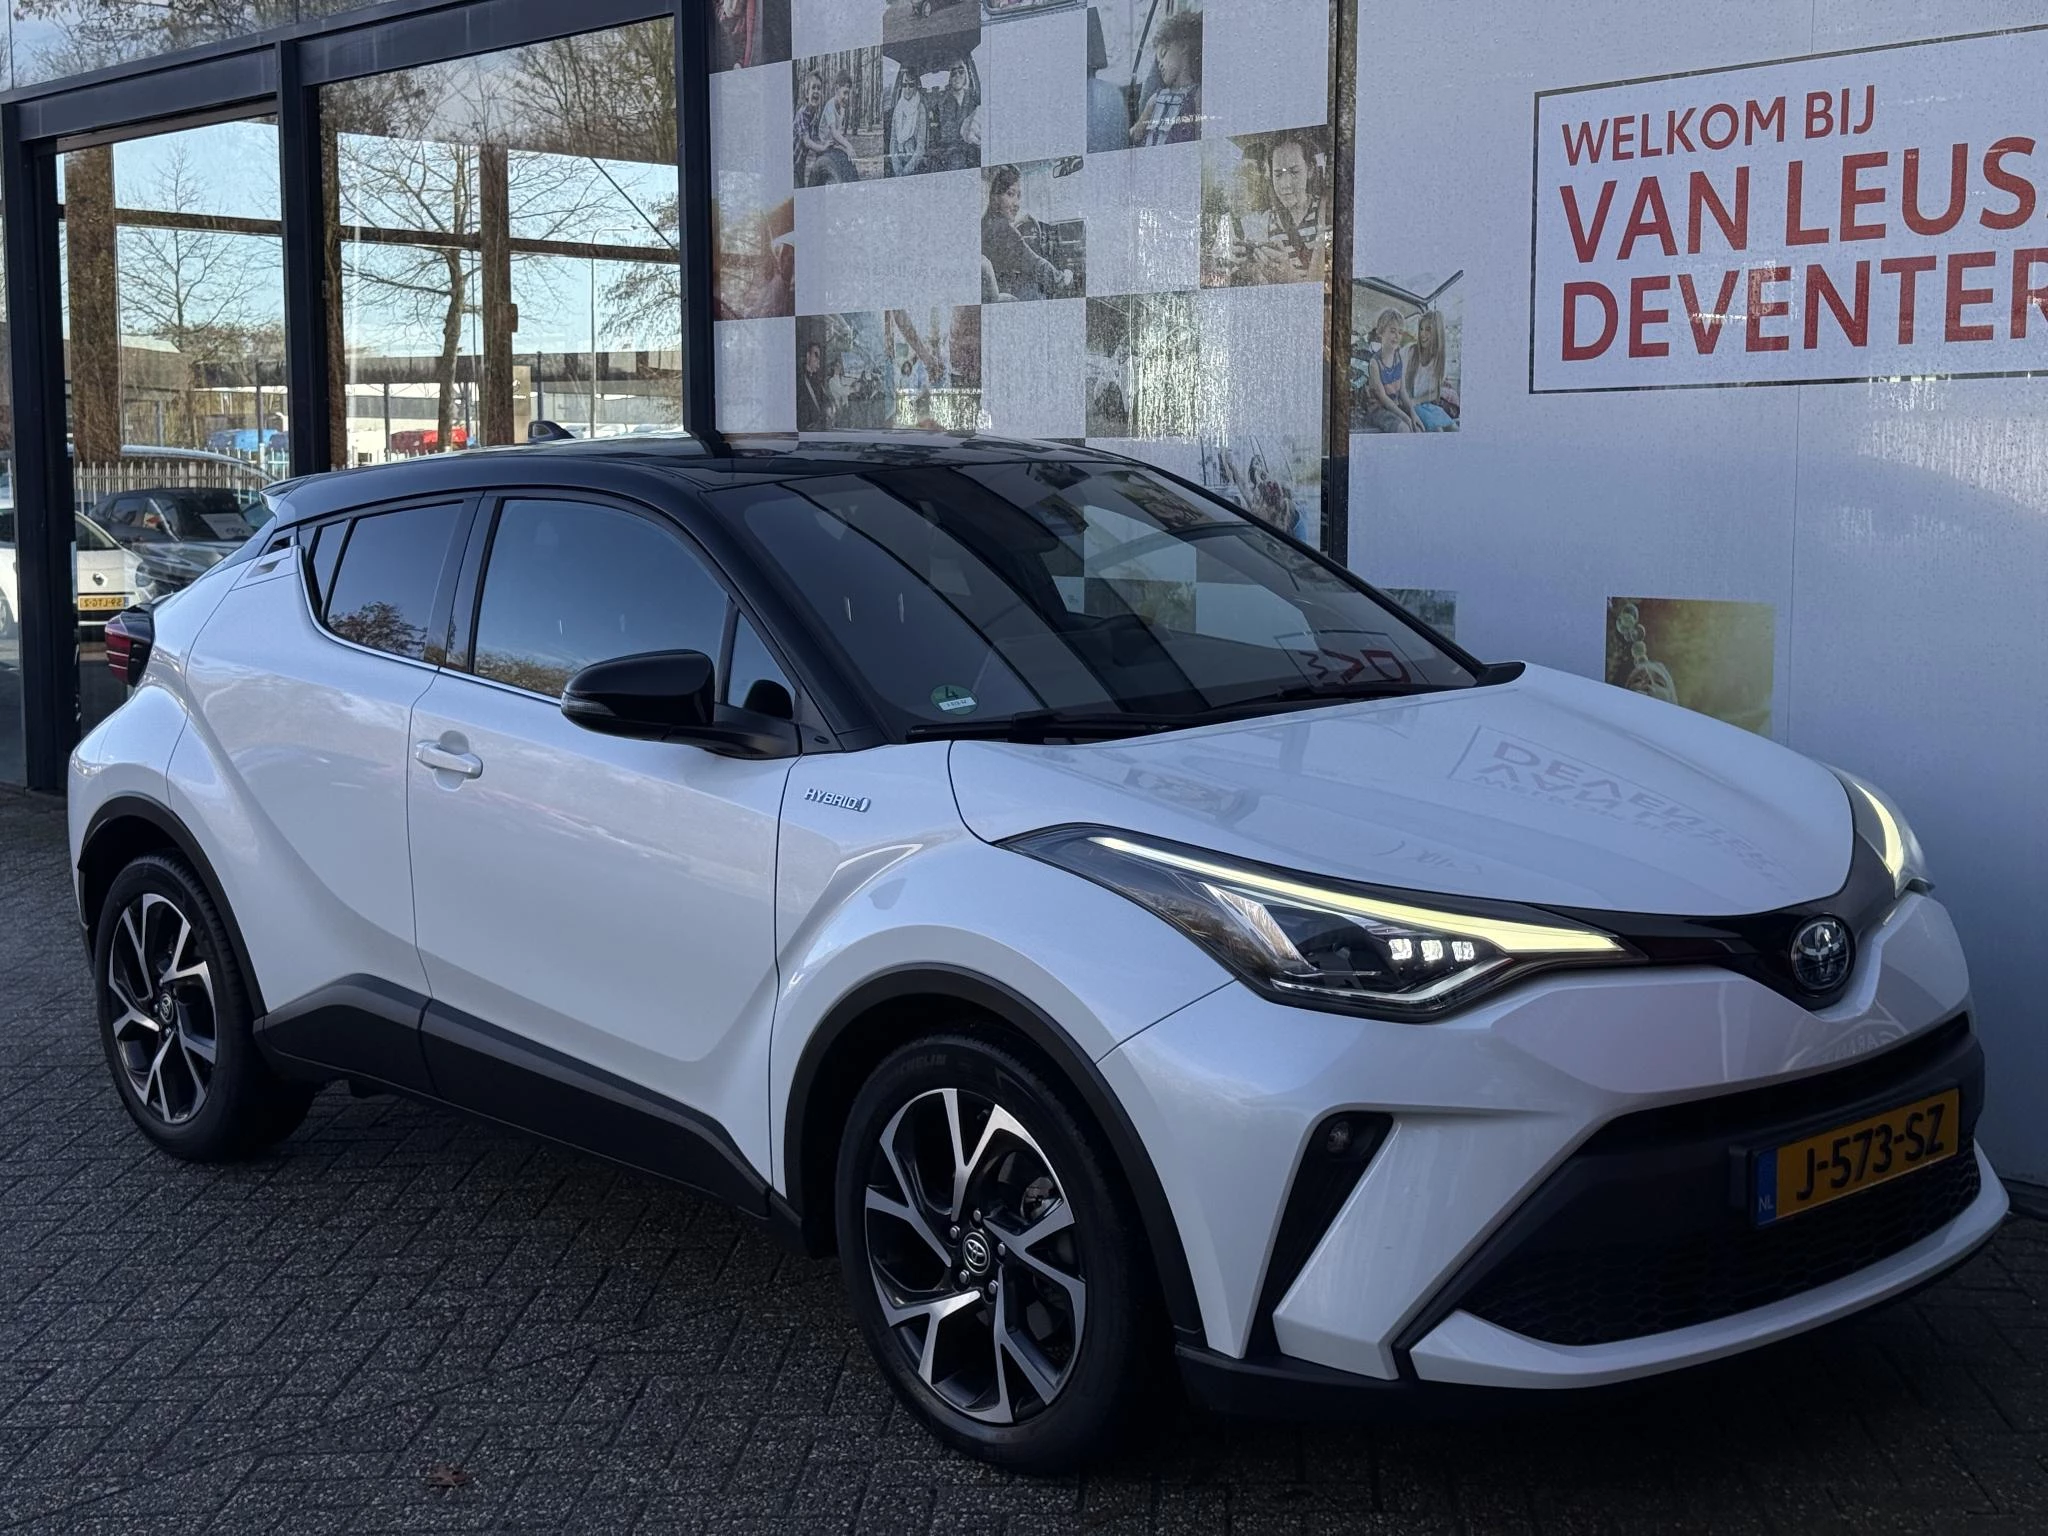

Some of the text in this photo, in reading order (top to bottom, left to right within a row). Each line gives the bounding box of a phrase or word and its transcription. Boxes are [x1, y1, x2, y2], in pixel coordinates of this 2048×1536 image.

[1562, 85, 1875, 165] WELKOM BIJ
[1560, 137, 2048, 263] VAN LEUS
[1562, 248, 2048, 360] DEVENTER
[804, 787, 859, 811] HYBRID
[1758, 1103, 1946, 1214] NL J-573-SZ
